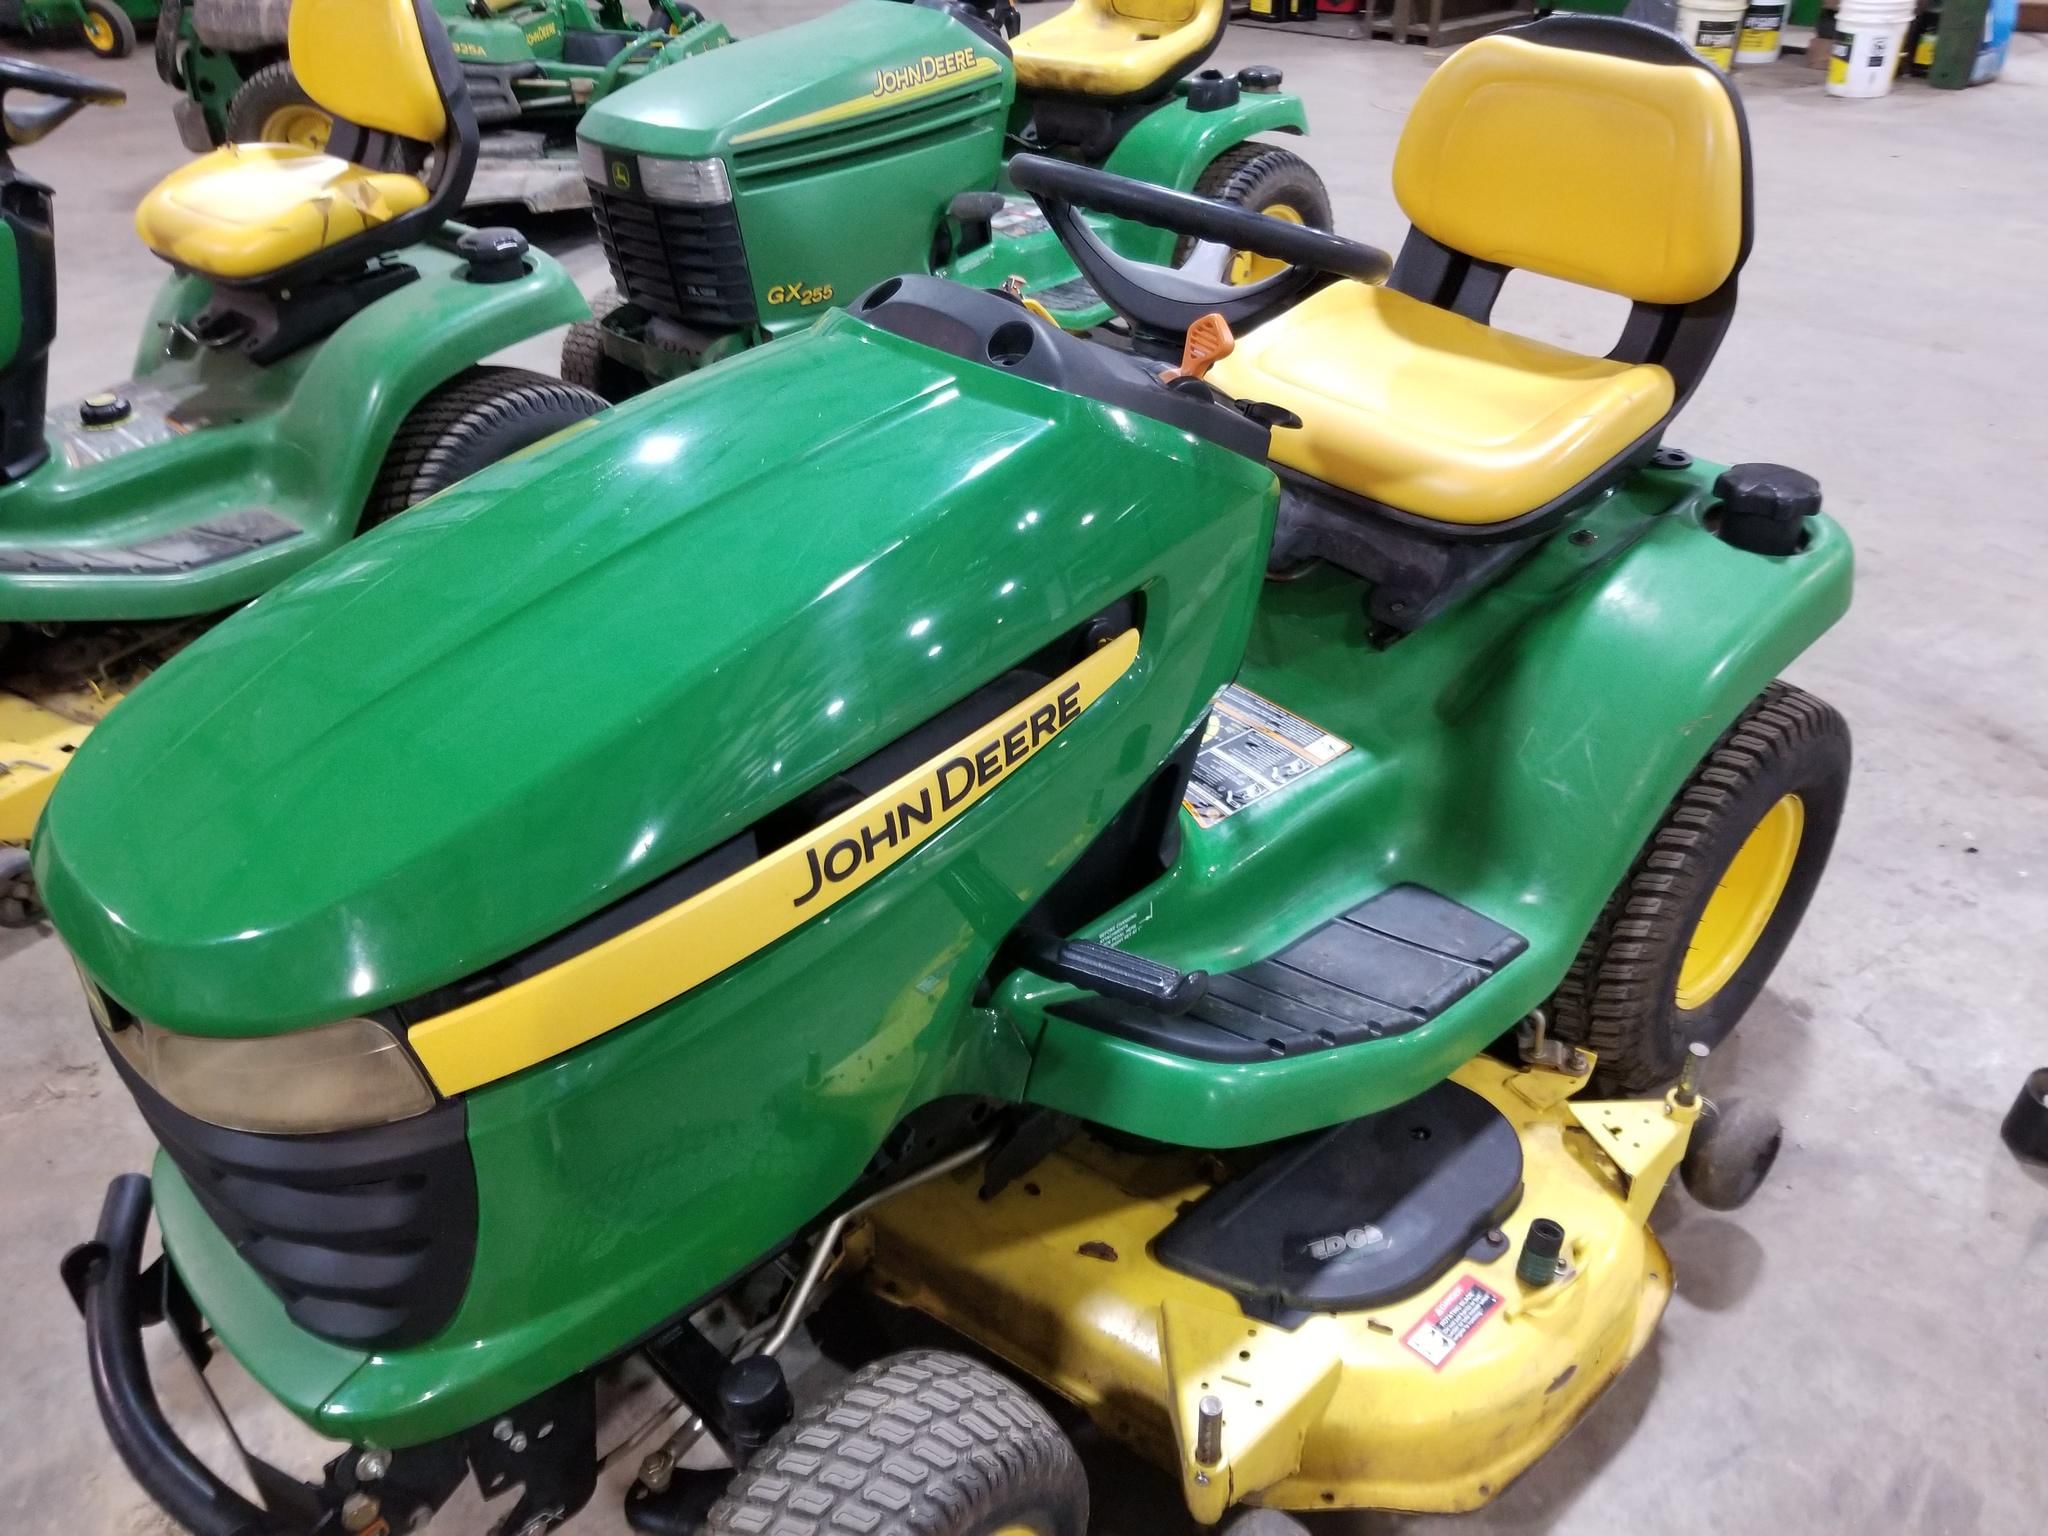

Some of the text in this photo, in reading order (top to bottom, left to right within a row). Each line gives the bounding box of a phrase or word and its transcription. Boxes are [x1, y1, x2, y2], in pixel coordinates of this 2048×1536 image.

[873, 47, 977, 97] JOHN DEERE
[793, 787, 932, 907] JOHN
[936, 681, 1081, 812] DEERE
